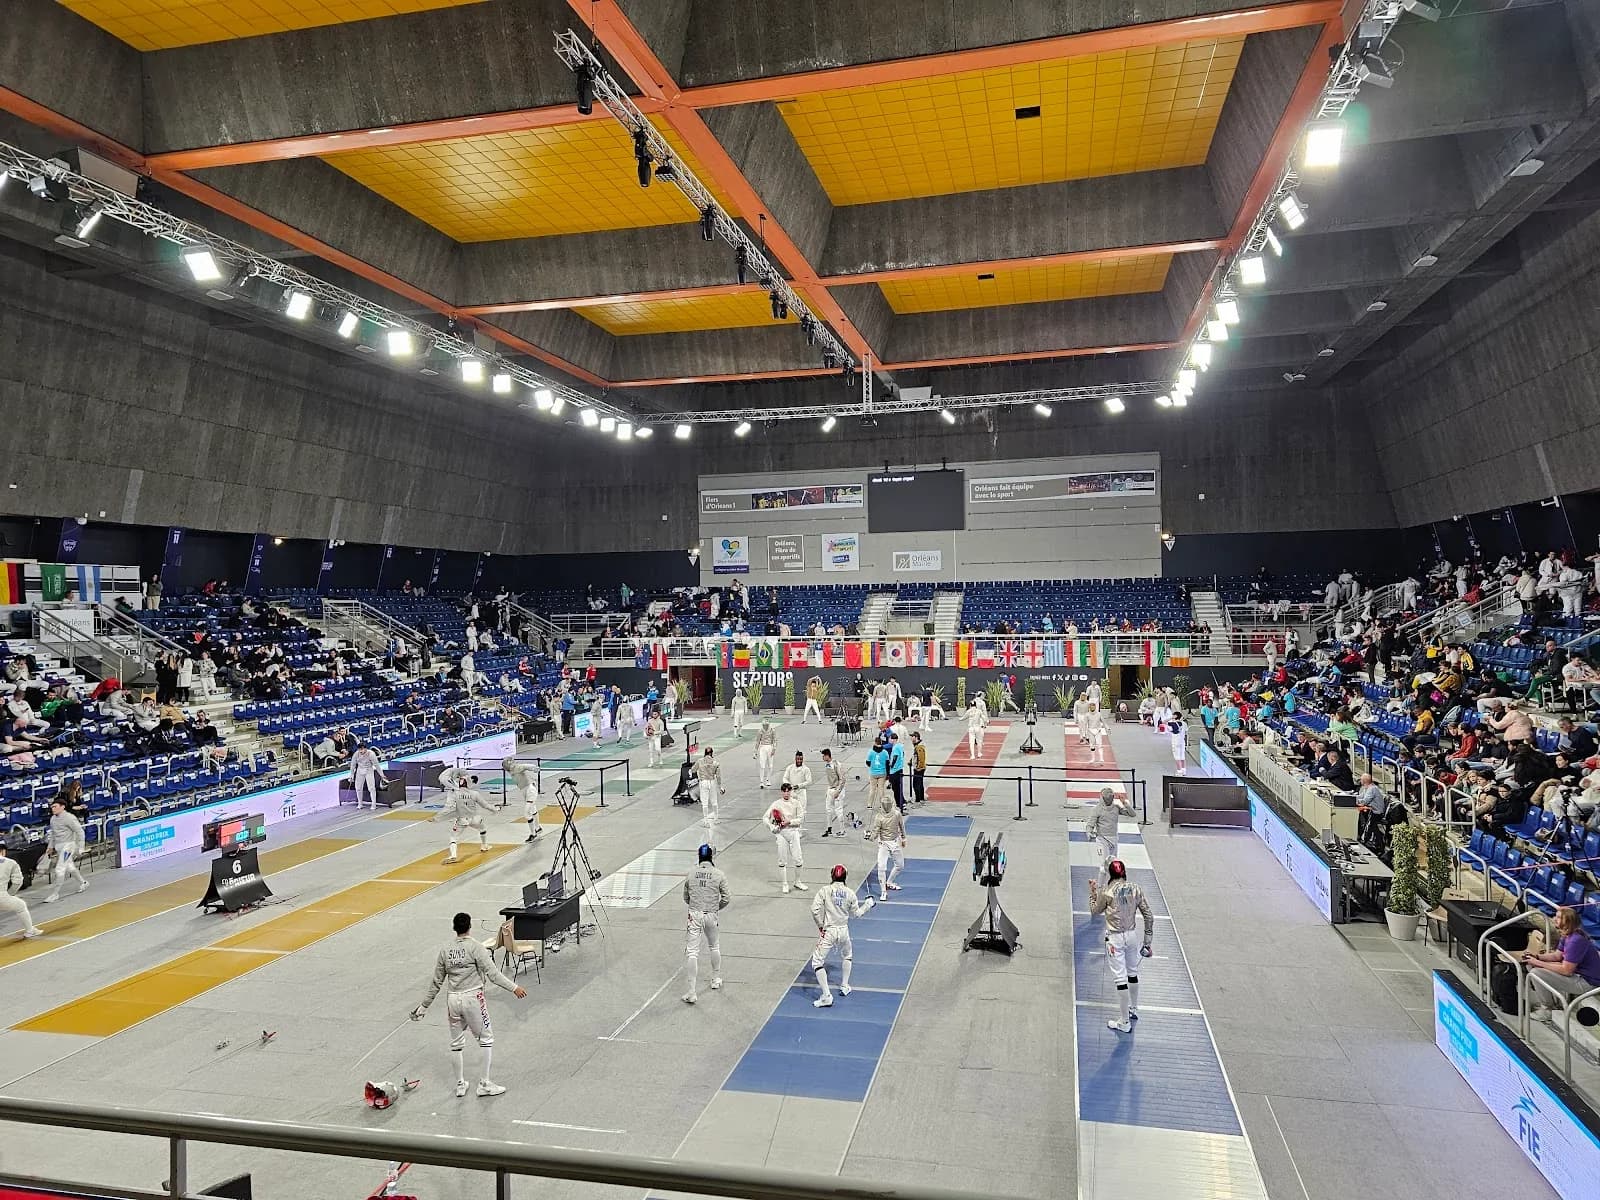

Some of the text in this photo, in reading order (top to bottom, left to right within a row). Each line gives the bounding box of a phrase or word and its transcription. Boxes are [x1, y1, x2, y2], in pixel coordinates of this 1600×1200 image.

[1012, 483, 1034, 491] équipe
[283, 804, 296, 818] FIE
[132, 834, 155, 845] GRAND
[232, 860, 242, 874] 6
[1519, 1112, 1540, 1162] FIE
